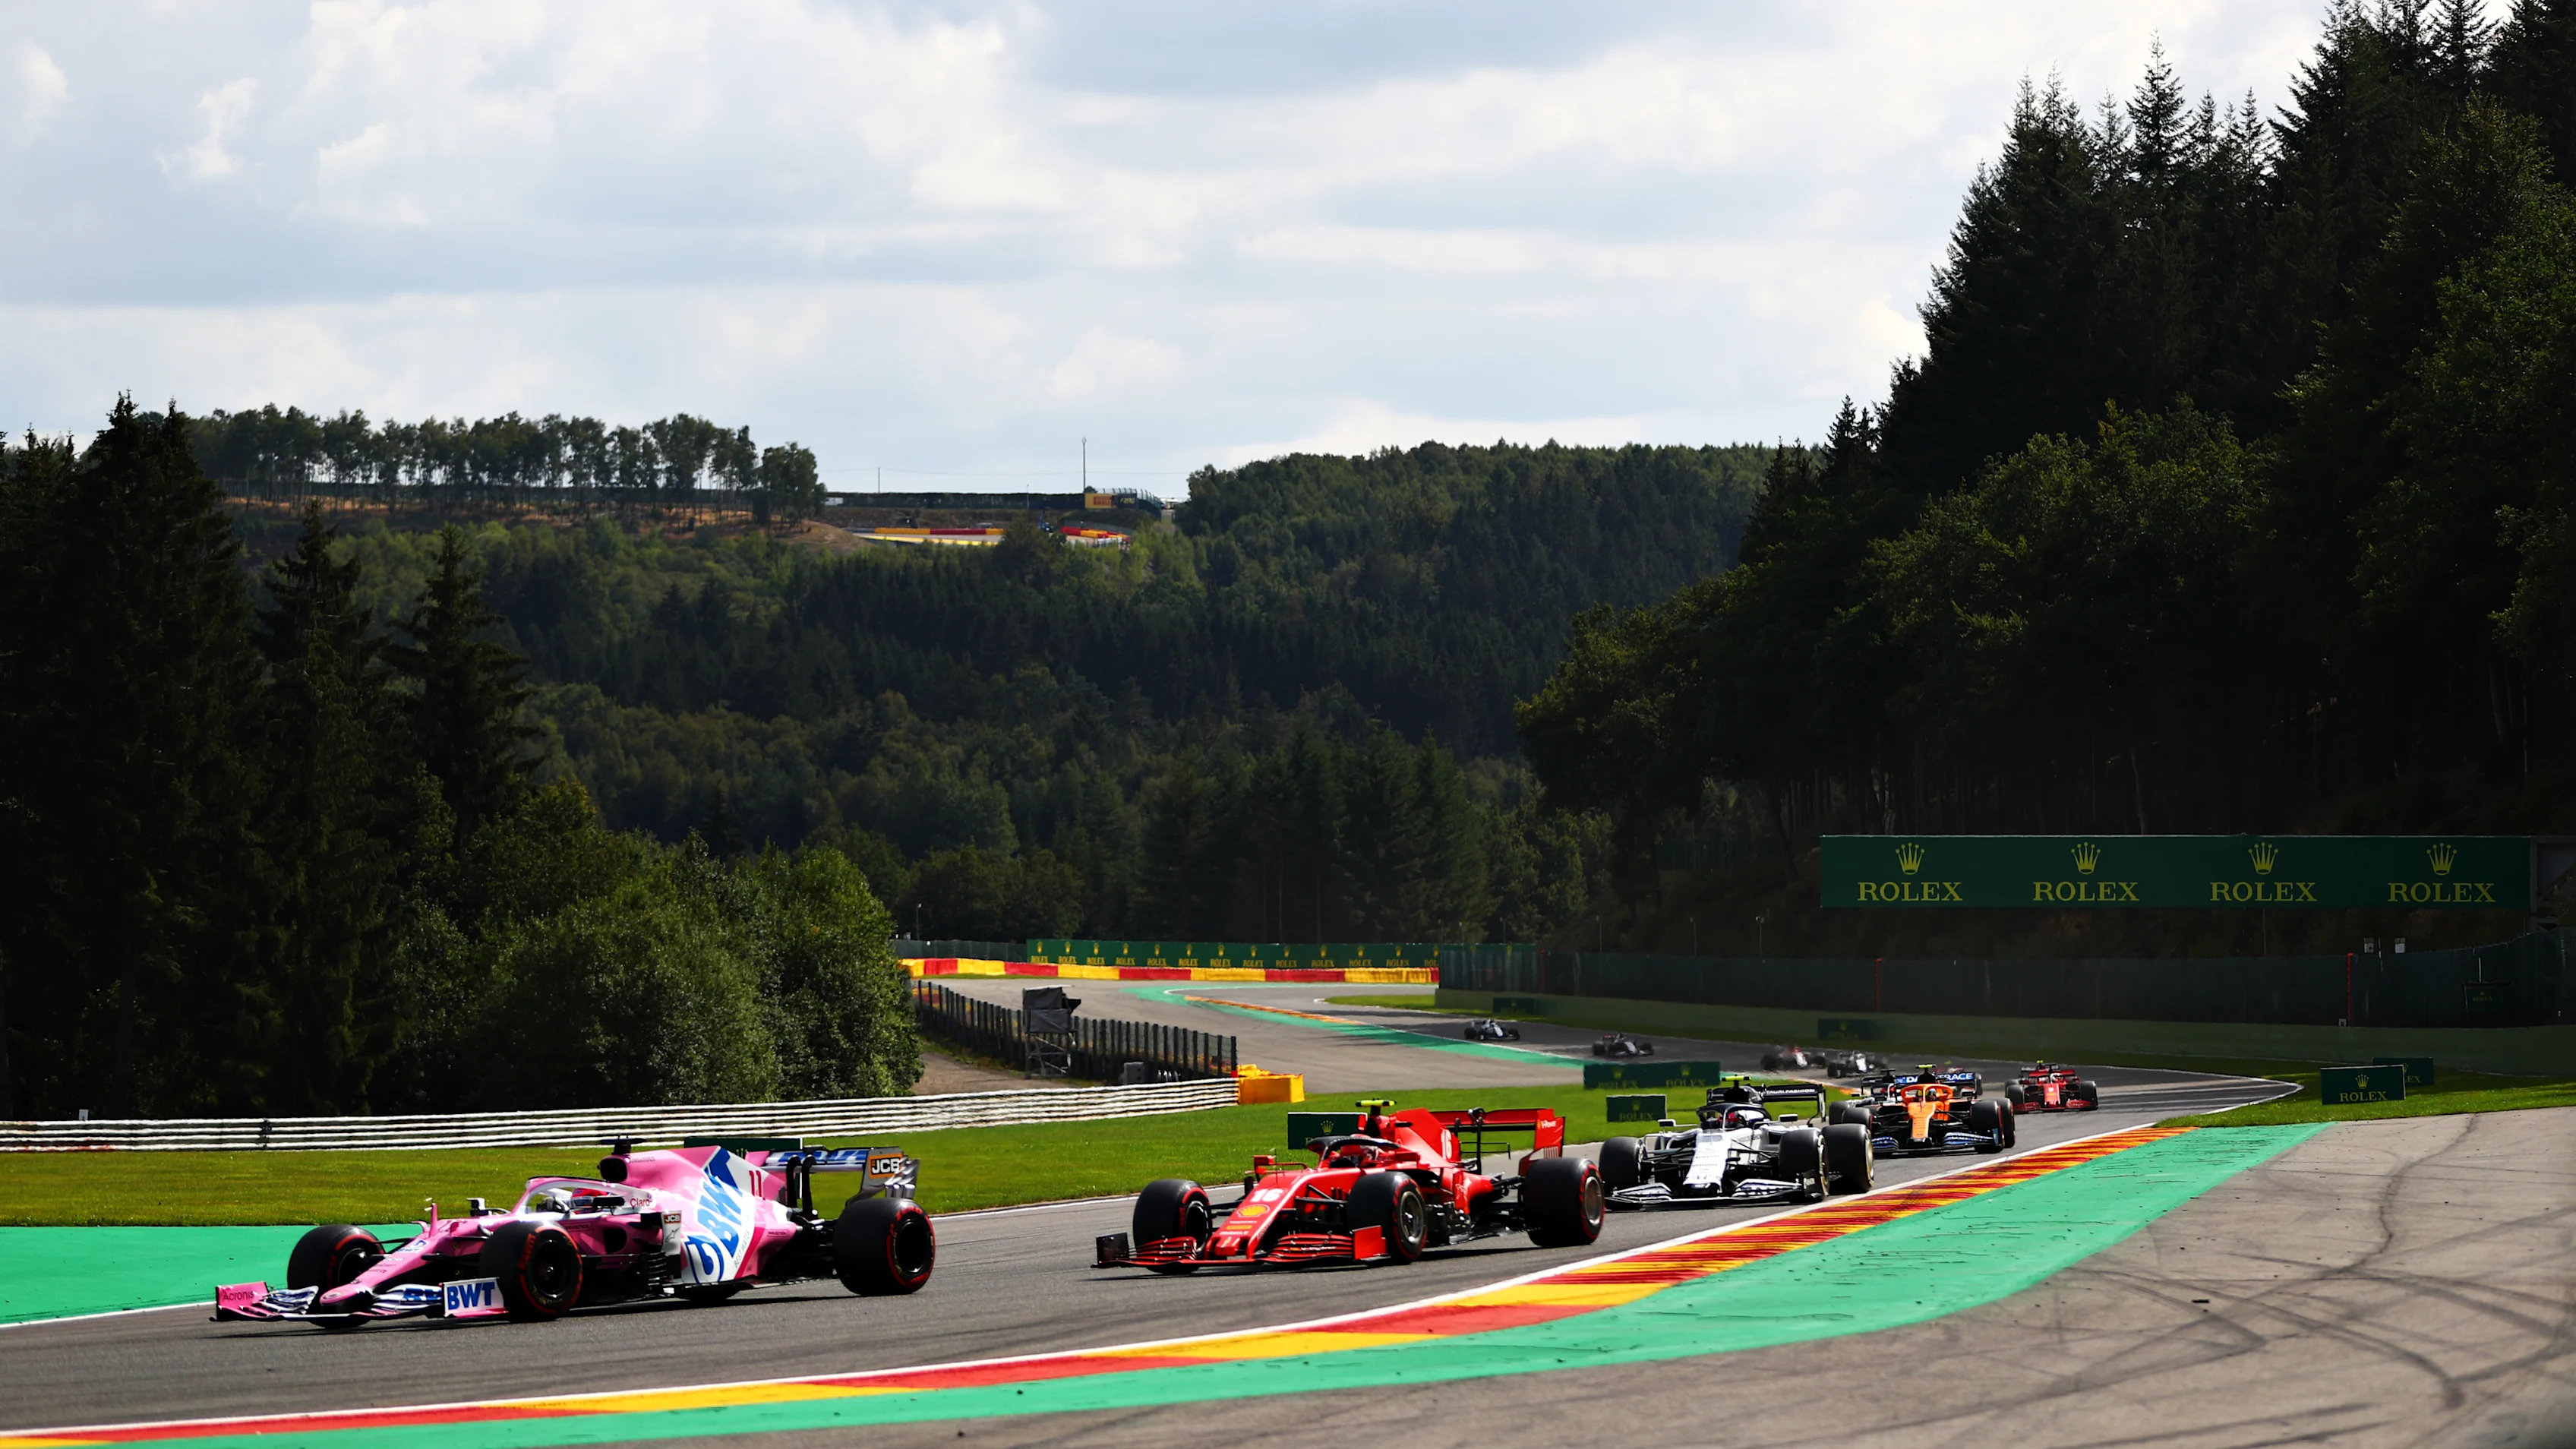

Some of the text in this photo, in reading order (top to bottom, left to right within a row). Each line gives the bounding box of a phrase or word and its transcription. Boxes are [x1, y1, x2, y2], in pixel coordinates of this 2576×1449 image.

[1857, 882, 2496, 902] ROLEX ROLEX ROLEX ROLEX
[1115, 957, 1135, 965] ROLEX
[1147, 958, 1166, 966] ROLEX
[1178, 958, 1198, 967] ROLEX
[1210, 958, 1231, 967] ROLEX
[1242, 959, 1264, 968] ROLEX
[1276, 959, 1297, 968] ROLEX
[1312, 959, 1334, 968] ROLEX
[1386, 959, 1410, 968] ROLEX
[1598, 1078, 1706, 1089] ROLEX ROLEX
[2339, 1091, 2388, 1102] ROLEX
[1619, 1112, 1654, 1121] ROLEX
[871, 1158, 901, 1174] JCB
[749, 1170, 765, 1200] 11
[1250, 1188, 1284, 1202] 16
[630, 1198, 652, 1208] Claro
[223, 1290, 255, 1302] Acronis
[447, 1282, 495, 1310] BWT
